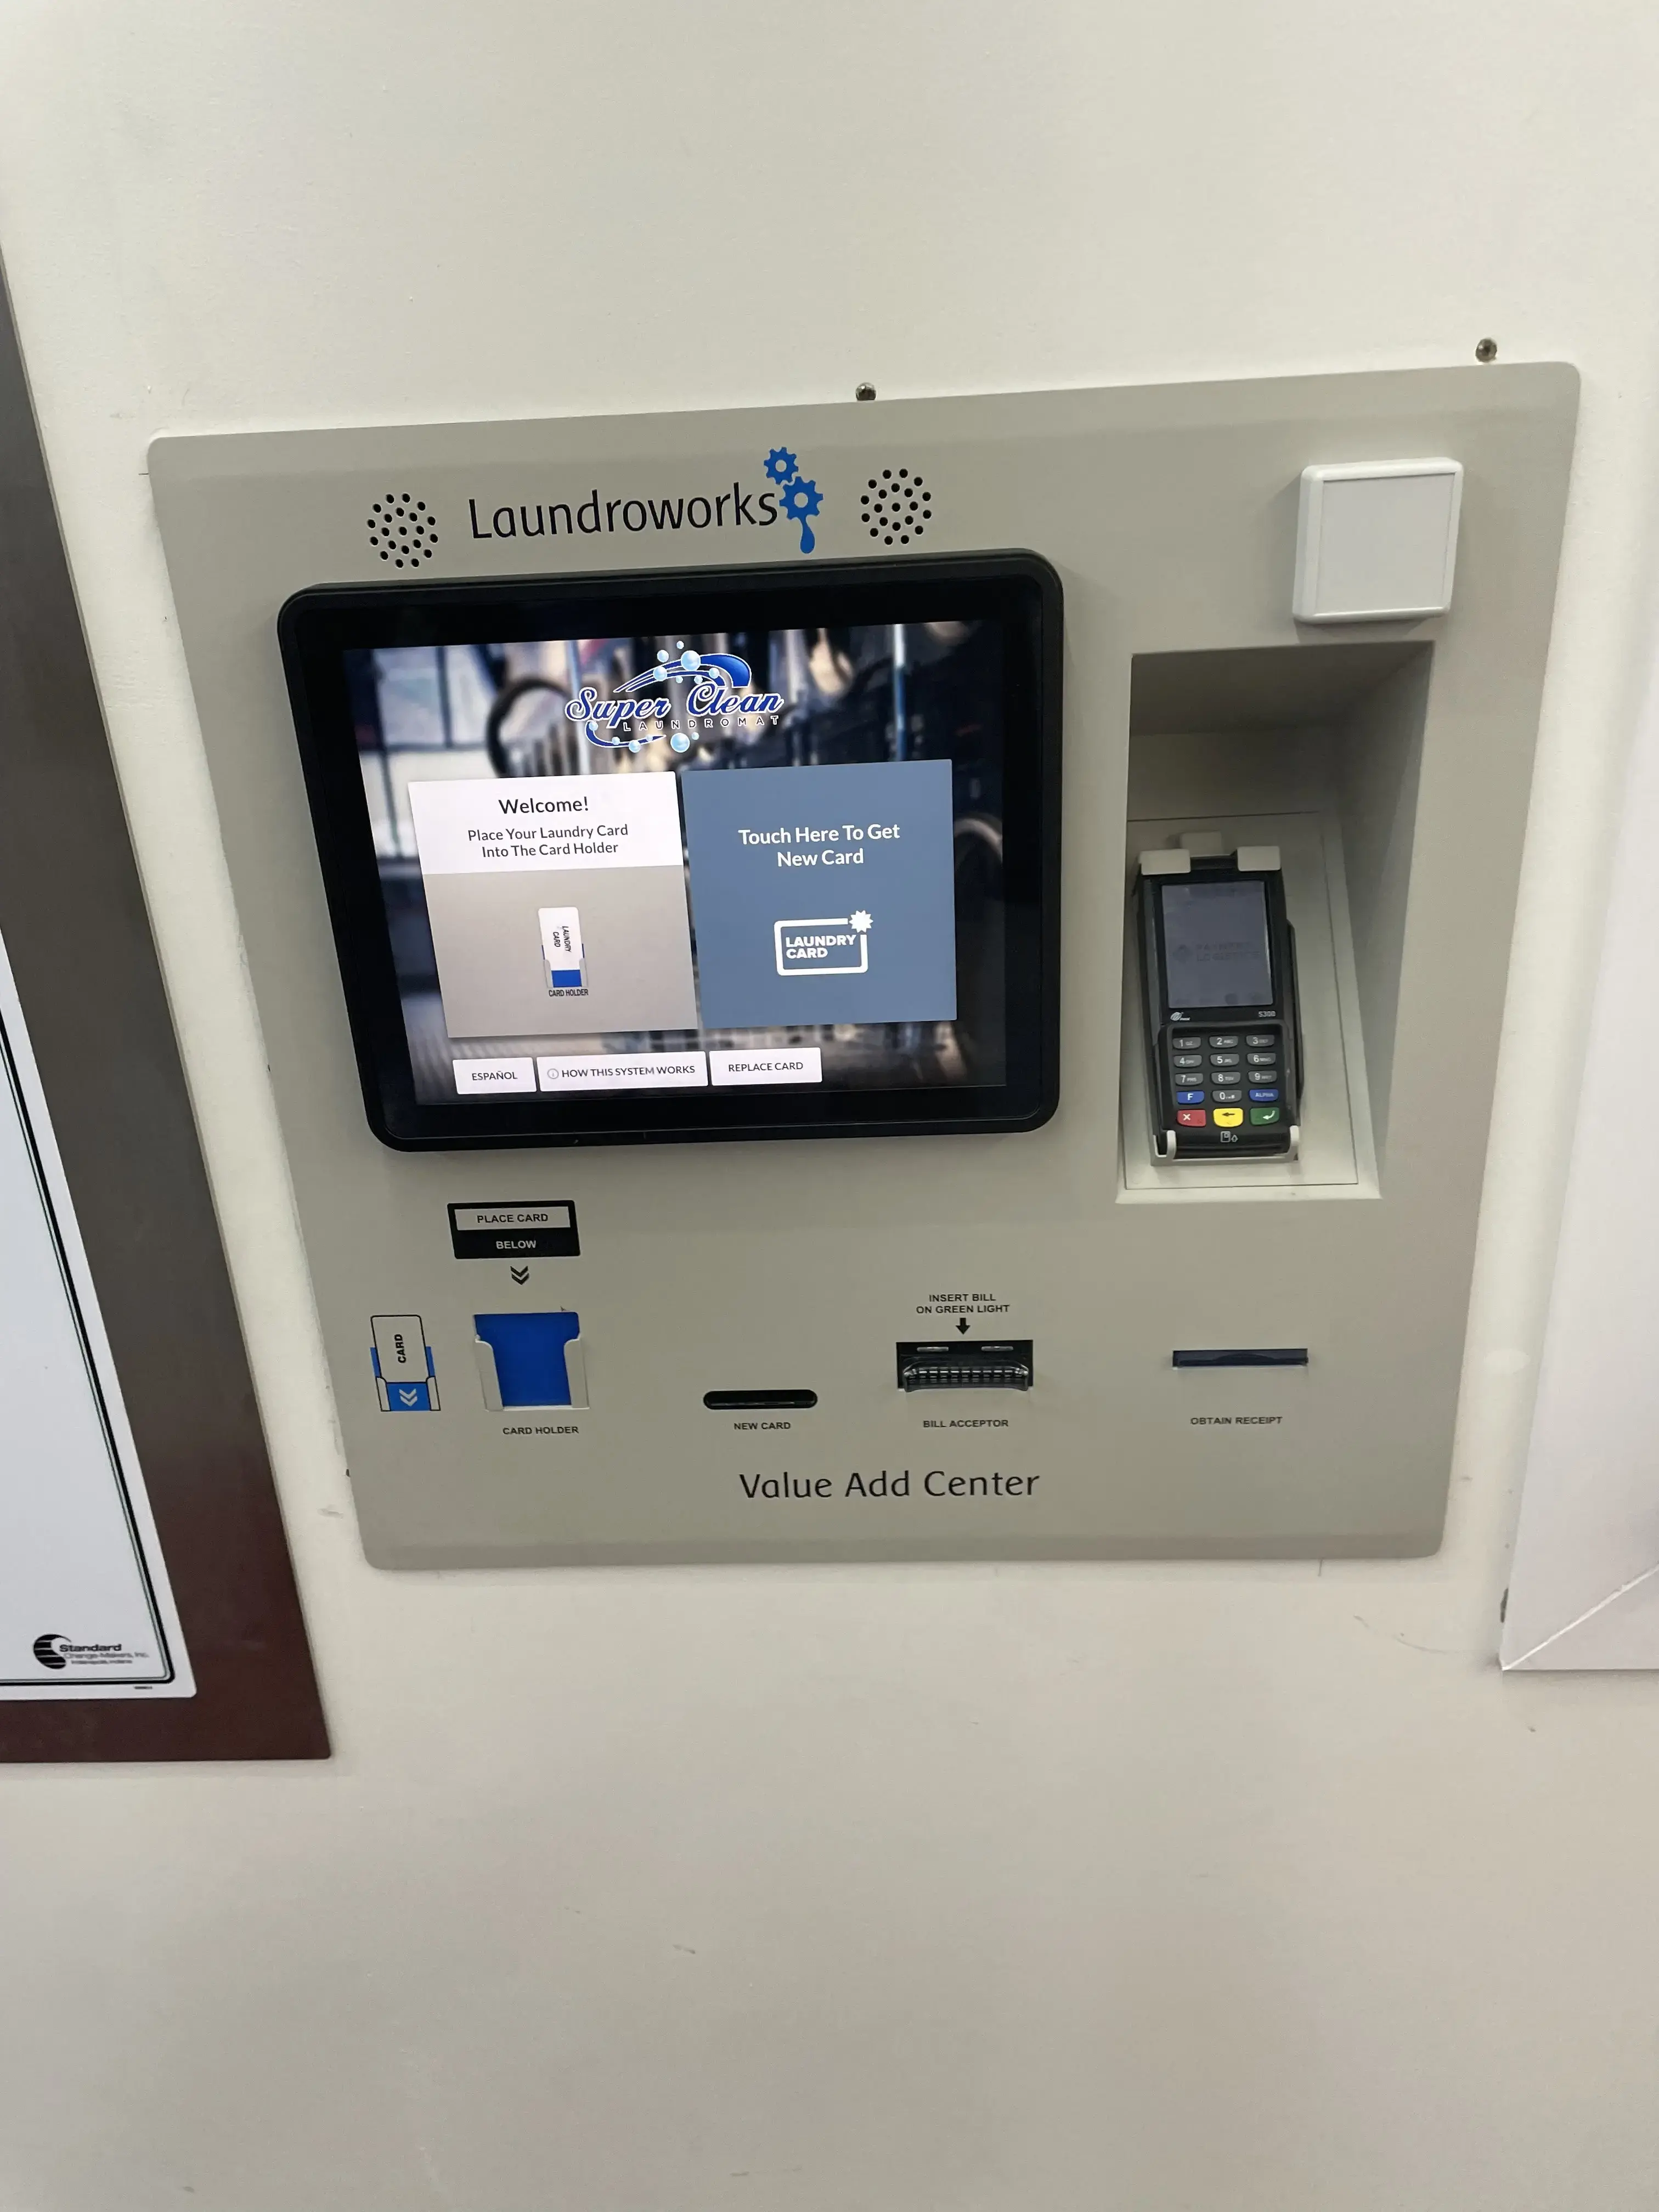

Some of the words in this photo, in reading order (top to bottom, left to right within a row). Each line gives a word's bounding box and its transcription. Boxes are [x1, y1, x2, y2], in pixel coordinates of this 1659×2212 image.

[469, 481, 778, 539] Laundroworks
[565, 687, 672, 729] Super
[686, 681, 784, 717] Clean
[623, 715, 779, 732] LAUNDROMAT
[498, 796, 589, 814] Welcome!
[467, 829, 504, 841] Place
[505, 828, 537, 840] Your
[540, 825, 594, 839] Laundry
[597, 823, 628, 836] Card
[738, 827, 791, 845] Touch
[795, 827, 839, 843] Here
[842, 825, 864, 840] To
[867, 823, 900, 839] Get
[482, 847, 509, 857] Into
[510, 844, 537, 856] The
[539, 843, 571, 855] Card
[573, 842, 619, 854] Holder
[777, 851, 818, 867] New
[821, 848, 864, 865] Card
[552, 932, 561, 947] CARD
[562, 926, 572, 952] LAUNDRY
[786, 934, 856, 947] LAUNDRY
[786, 947, 828, 959] CARD
[548, 989, 565, 997] CARD
[1179, 1039, 1183, 1047] 1
[1217, 1056, 1223, 1064] 5
[562, 1069, 588, 1077] HOW
[590, 1068, 613, 1076] THIS
[615, 1067, 654, 1076] SYSTEM
[657, 1065, 695, 1074] WORKS
[728, 1063, 773, 1072] REPLACE
[775, 1062, 803, 1070] CARD
[472, 1070, 518, 1081] ESPAÑOL
[1181, 1075, 1186, 1083] 7
[1218, 1074, 1224, 1082] 8
[1219, 1092, 1226, 1100] 0
[477, 1214, 515, 1223] PLACE
[517, 1214, 548, 1222] CARD
[495, 1240, 537, 1249] BELOW
[929, 1294, 969, 1302] INSERT
[916, 1306, 932, 1314] ON
[935, 1305, 974, 1313] GREEN
[977, 1305, 1010, 1313] LIGHT
[394, 1334, 407, 1363] CARD
[923, 1420, 947, 1428] BILL
[949, 1419, 1009, 1427] ACCEPTOR
[1235, 1416, 1283, 1425] RECEIPT
[535, 1426, 579, 1435] HOLDER
[739, 1471, 832, 1498] Value
[845, 1470, 910, 1497] Add
[924, 1471, 1040, 1497] Center
[59, 1644, 122, 1652] Standard
